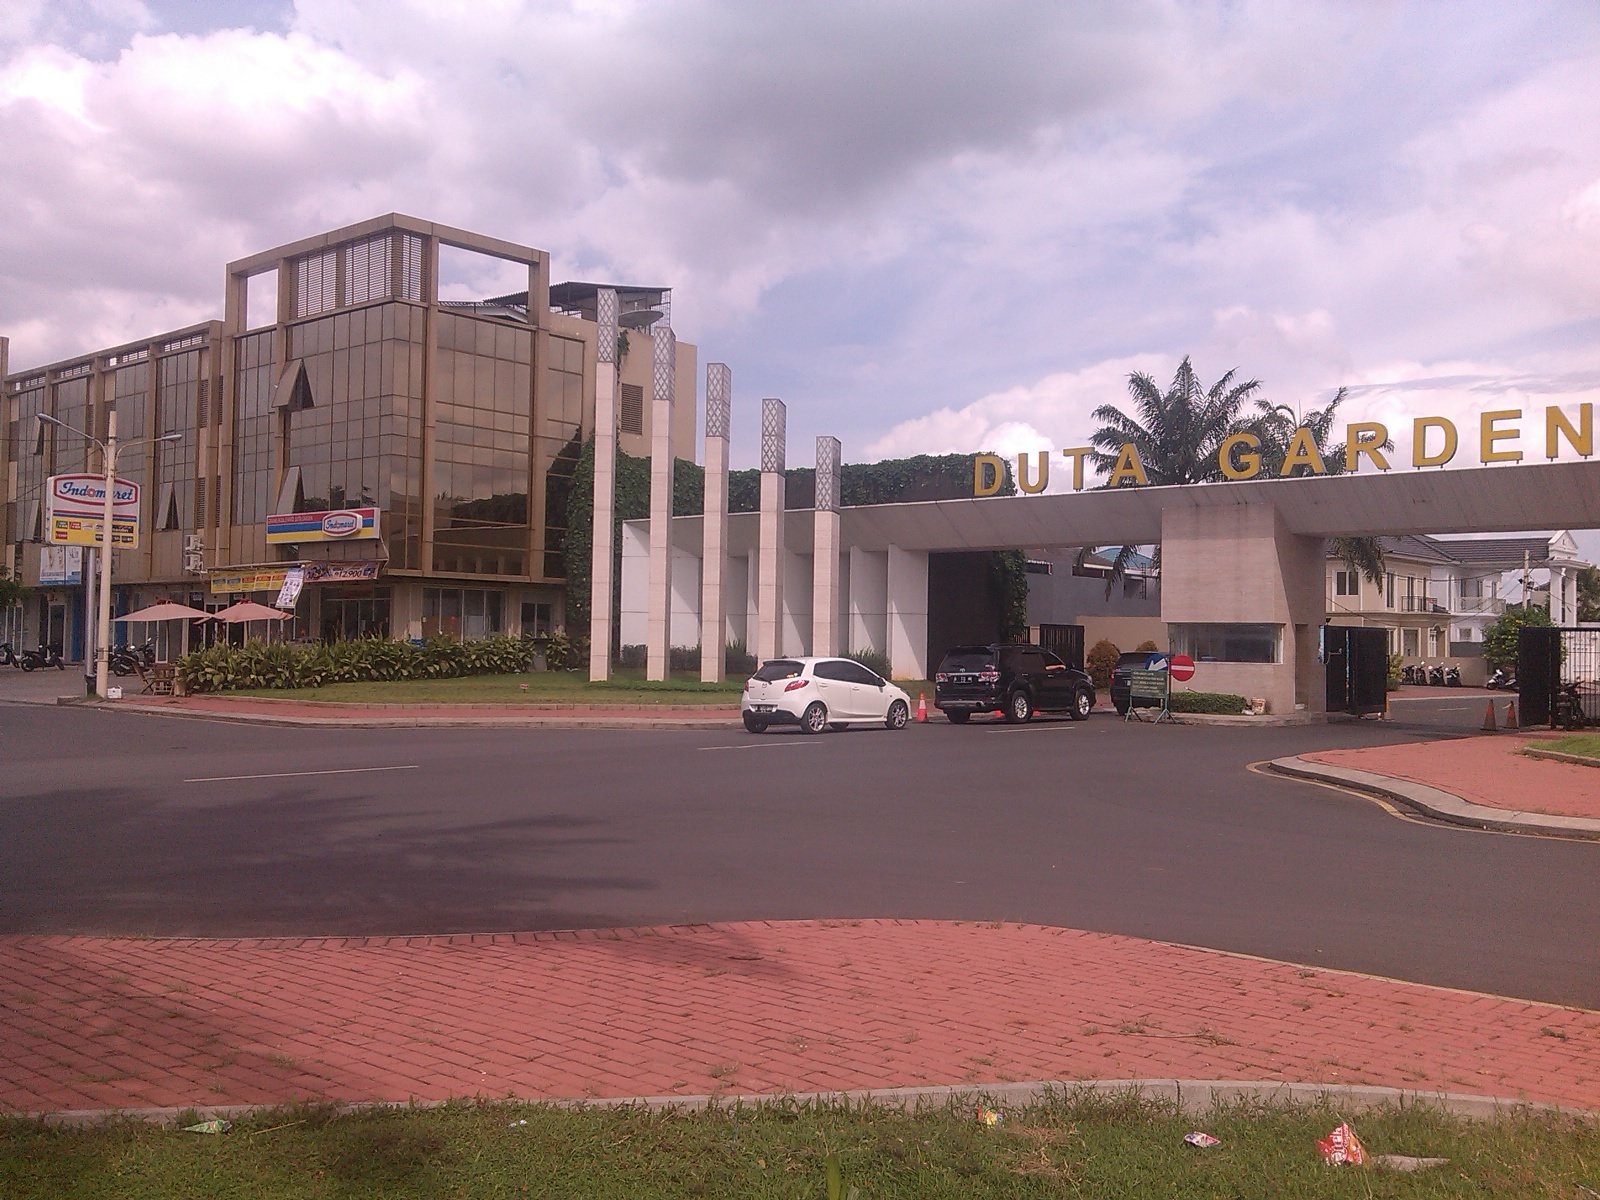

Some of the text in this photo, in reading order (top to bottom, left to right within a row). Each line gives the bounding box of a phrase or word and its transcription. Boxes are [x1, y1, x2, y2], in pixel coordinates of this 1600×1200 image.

[973, 403, 1593, 497] DUTA GARDEN
[59, 481, 134, 501] Indomret
